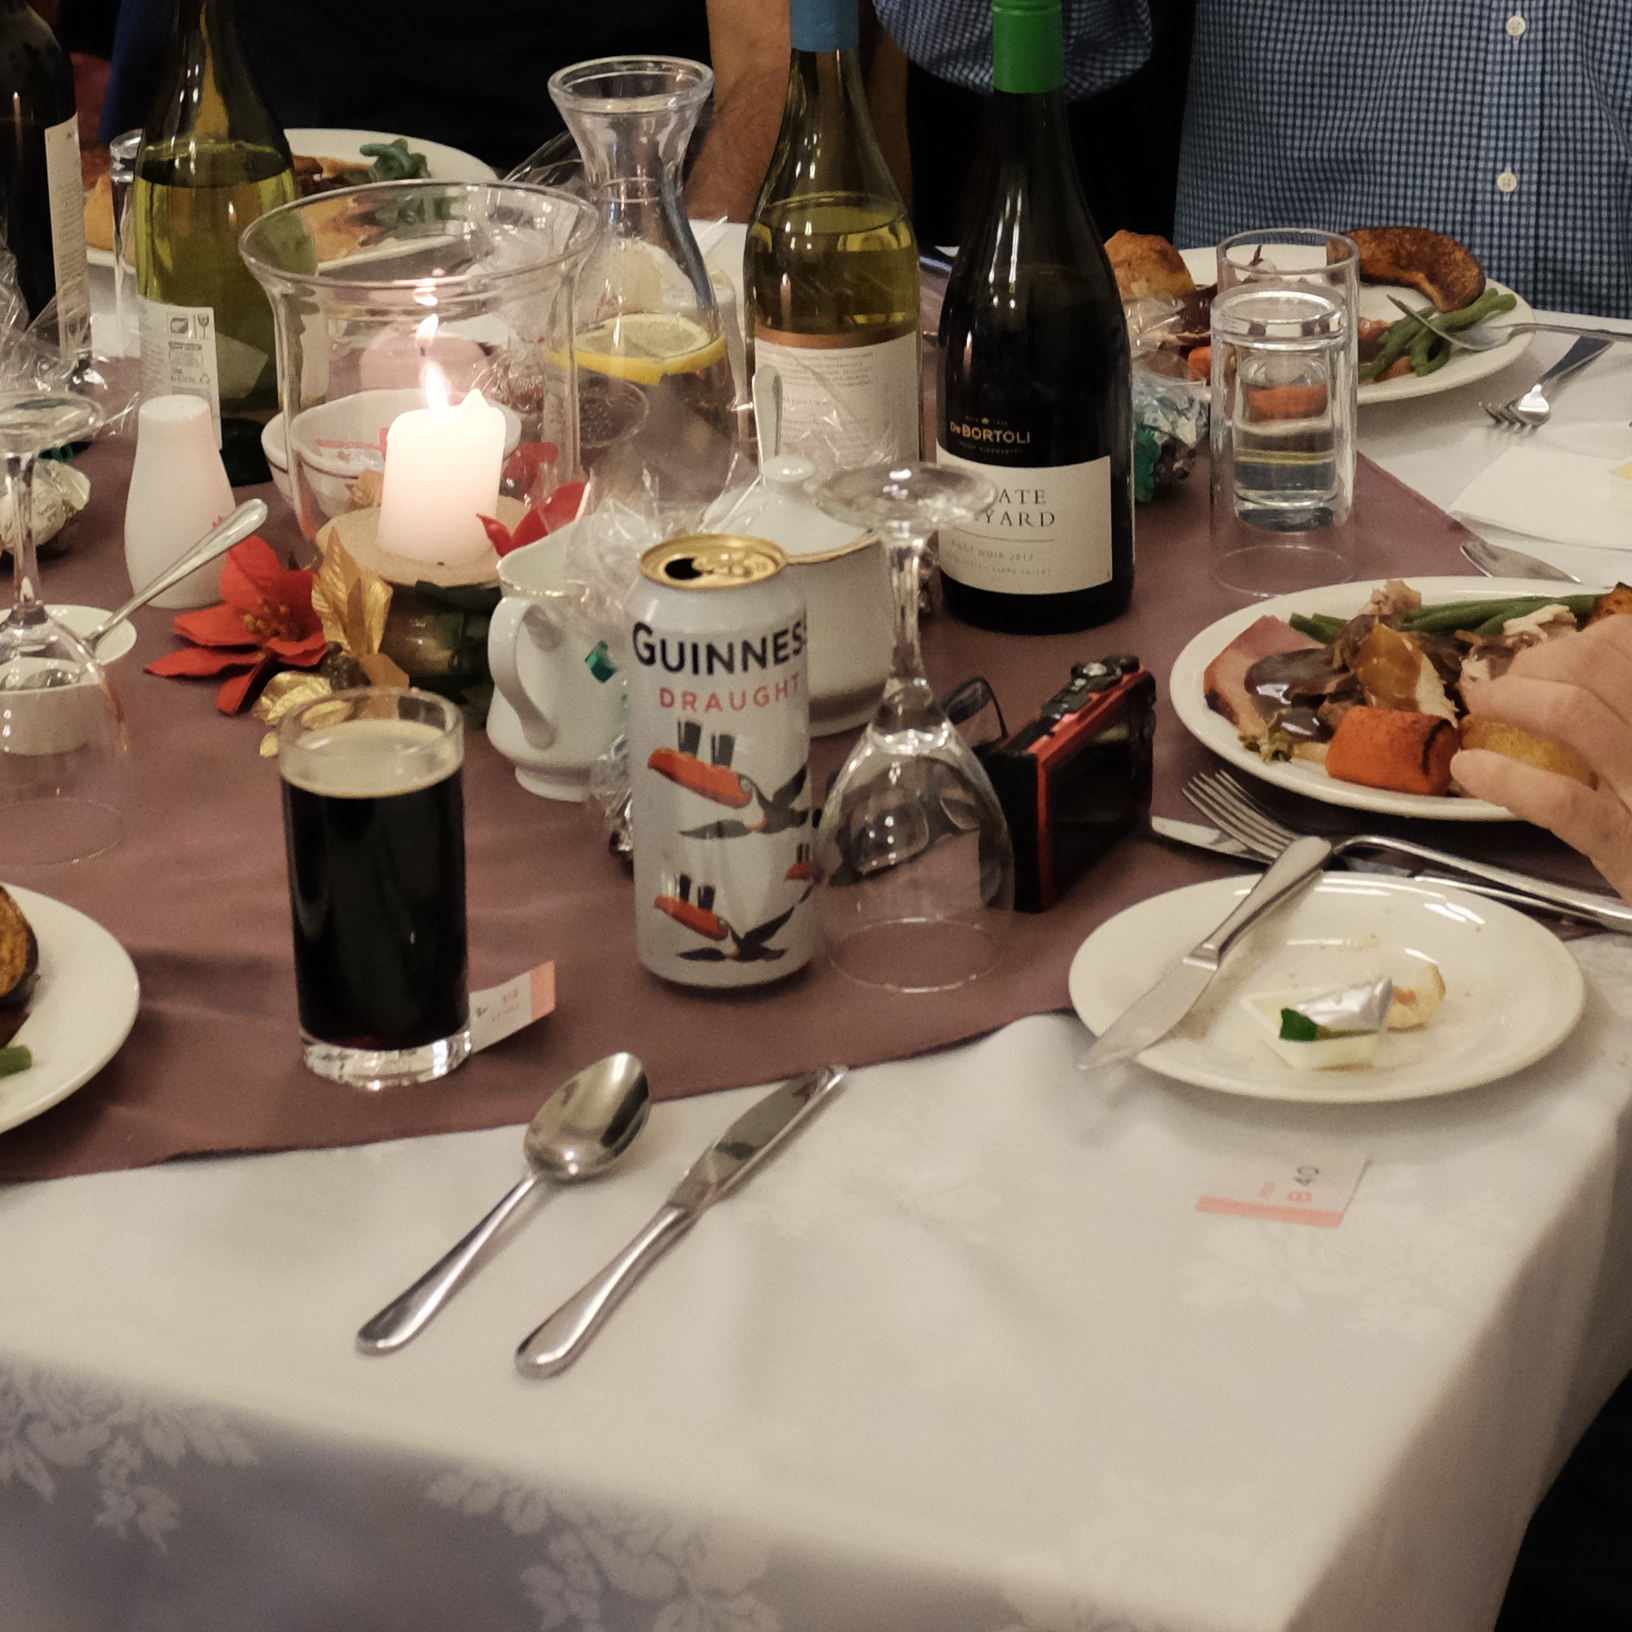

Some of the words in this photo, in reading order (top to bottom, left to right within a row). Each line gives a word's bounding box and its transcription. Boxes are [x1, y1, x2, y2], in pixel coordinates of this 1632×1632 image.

[998, 488, 1047, 505] ATE
[984, 509, 1056, 527] YARD
[632, 619, 807, 677] GUINNES
[658, 672, 801, 713] DRAUGHT
